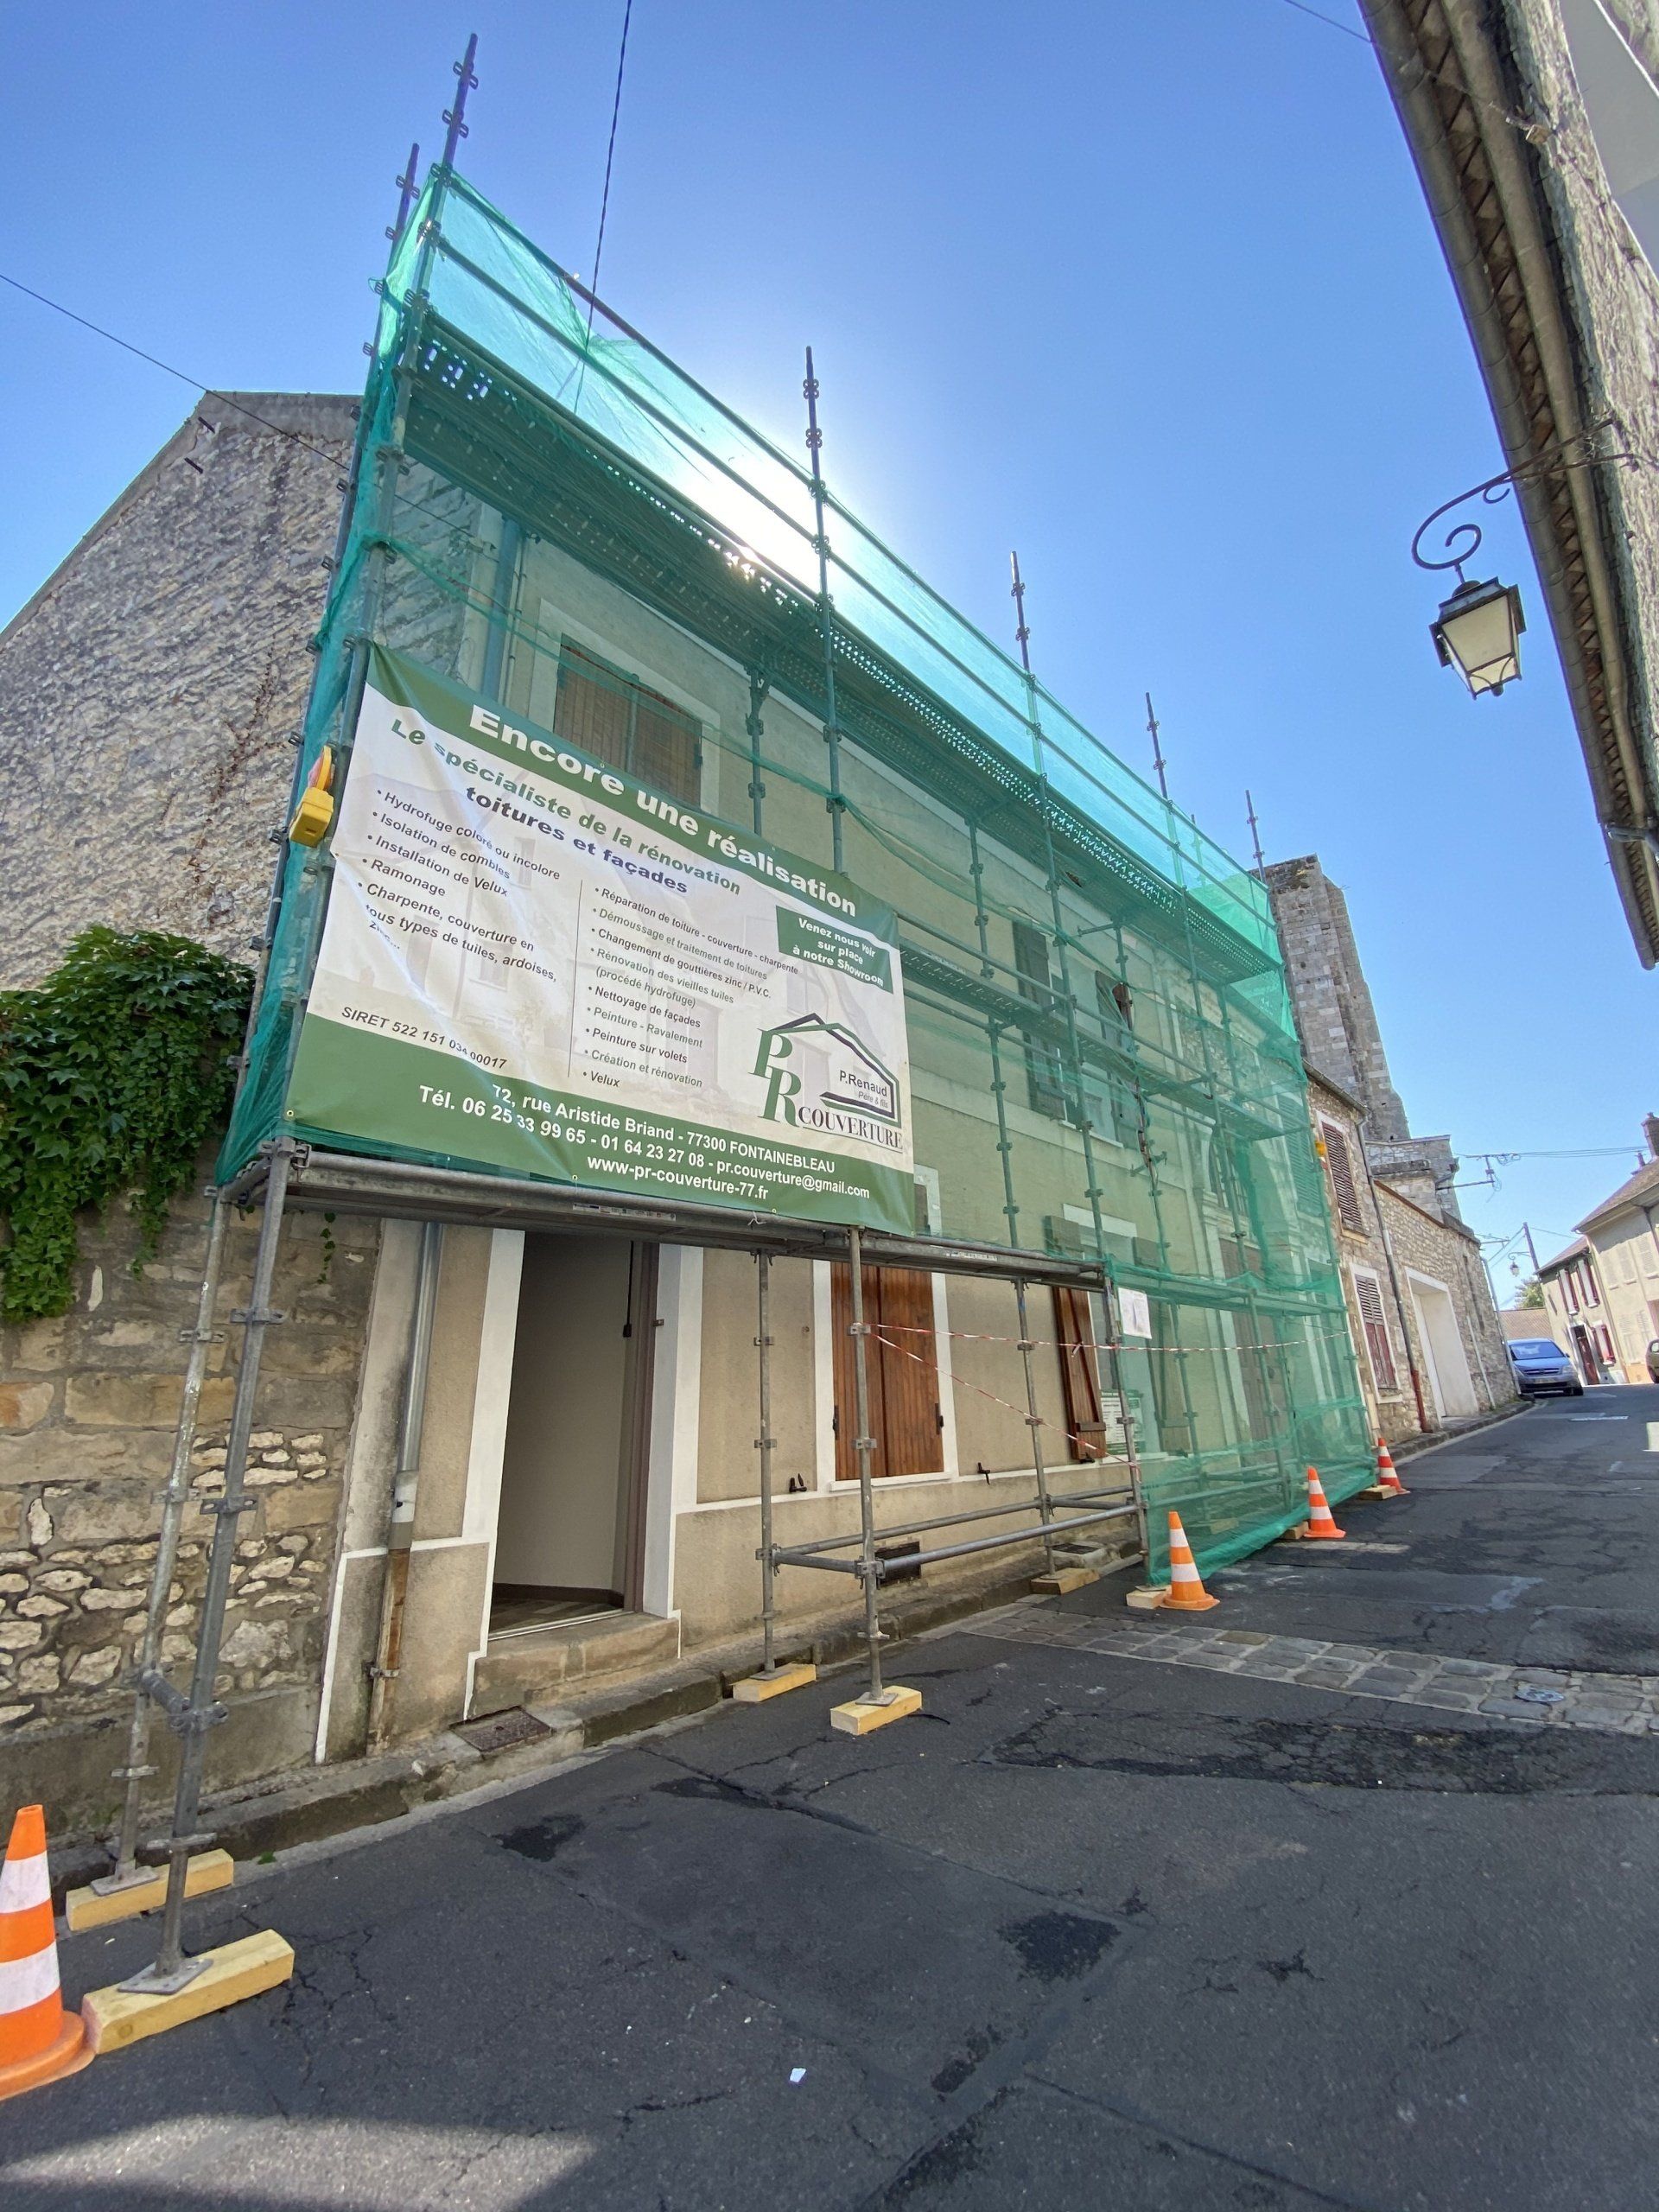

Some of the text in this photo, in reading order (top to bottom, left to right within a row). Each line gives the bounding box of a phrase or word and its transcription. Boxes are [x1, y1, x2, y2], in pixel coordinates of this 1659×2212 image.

[385, 792, 560, 880] Hydrofuge coloré ou incolore
[391, 719, 741, 896] Le spécialiste de la rénovation
[469, 704, 856, 917] Encore une réalisation
[376, 836, 508, 897] Installation de Velux
[381, 813, 511, 880] Isolation de combles
[467, 787, 688, 893] toitures et façades
[370, 859, 446, 897] Ramonage
[366, 883, 534, 951] Charpente, couverture en
[599, 908, 767, 980] Démoussage et traitement de toitures
[601, 888, 656, 917] Réparation
[658, 912, 670, 924] de
[672, 918, 700, 937] toiture
[707, 934, 753, 957] couverture
[760, 955, 798, 975] charpente
[798, 918, 876, 958] Venez nous voir
[399, 917, 439, 938] types
[442, 933, 459, 945] de
[462, 940, 498, 963] tuiles,
[502, 956, 556, 982] ardoises,
[597, 948, 734, 1003] Rénovation des vieilles tuiles
[598, 928, 662, 961] Changement
[663, 954, 675, 964] de
[677, 959, 722, 982] gouttières
[724, 976, 742, 988] zinc
[792, 944, 884, 987] à notre Showroom
[817, 940, 863, 965] sur place
[594, 986, 701, 1028] Nettoyage de façades
[595, 966, 696, 1009] (procédé hydrofuge)
[341, 1007, 391, 1028] SIRET
[391, 1021, 418, 1037] 522
[423, 1031, 445, 1045] 151
[470, 1052, 507, 1069] 00017
[592, 1027, 688, 1063] Peinture sur volets
[594, 1007, 638, 1028] Peinture
[646, 1024, 702, 1048] Ravalement
[590, 1071, 620, 1088] Velux
[591, 1049, 702, 1088] Création et rénovation
[419, 1085, 455, 1109] Tél.
[462, 1097, 486, 1116] 06
[491, 1104, 512, 1123] 25
[517, 1114, 535, 1133] 33
[540, 1121, 562, 1139] 99
[565, 1127, 586, 1145] 65
[601, 1135, 619, 1152] 01
[624, 1139, 642, 1156] 64
[646, 1144, 664, 1160] 23
[668, 1147, 685, 1164] 27
[689, 1152, 704, 1167] 08
[716, 1160, 870, 1198] pr.couverture@gmail.com
[492, 1084, 516, 1108] 72,
[523, 1096, 551, 1113] rue
[555, 1103, 620, 1130] Aristide
[625, 1117, 674, 1141] Briand
[687, 1131, 727, 1152] 77300
[729, 1141, 836, 1173] FONTAINEBLEAU
[798, 1106, 903, 1150] COUVERTURE
[588, 1156, 769, 1200] www-pr-couverture-77.fr
